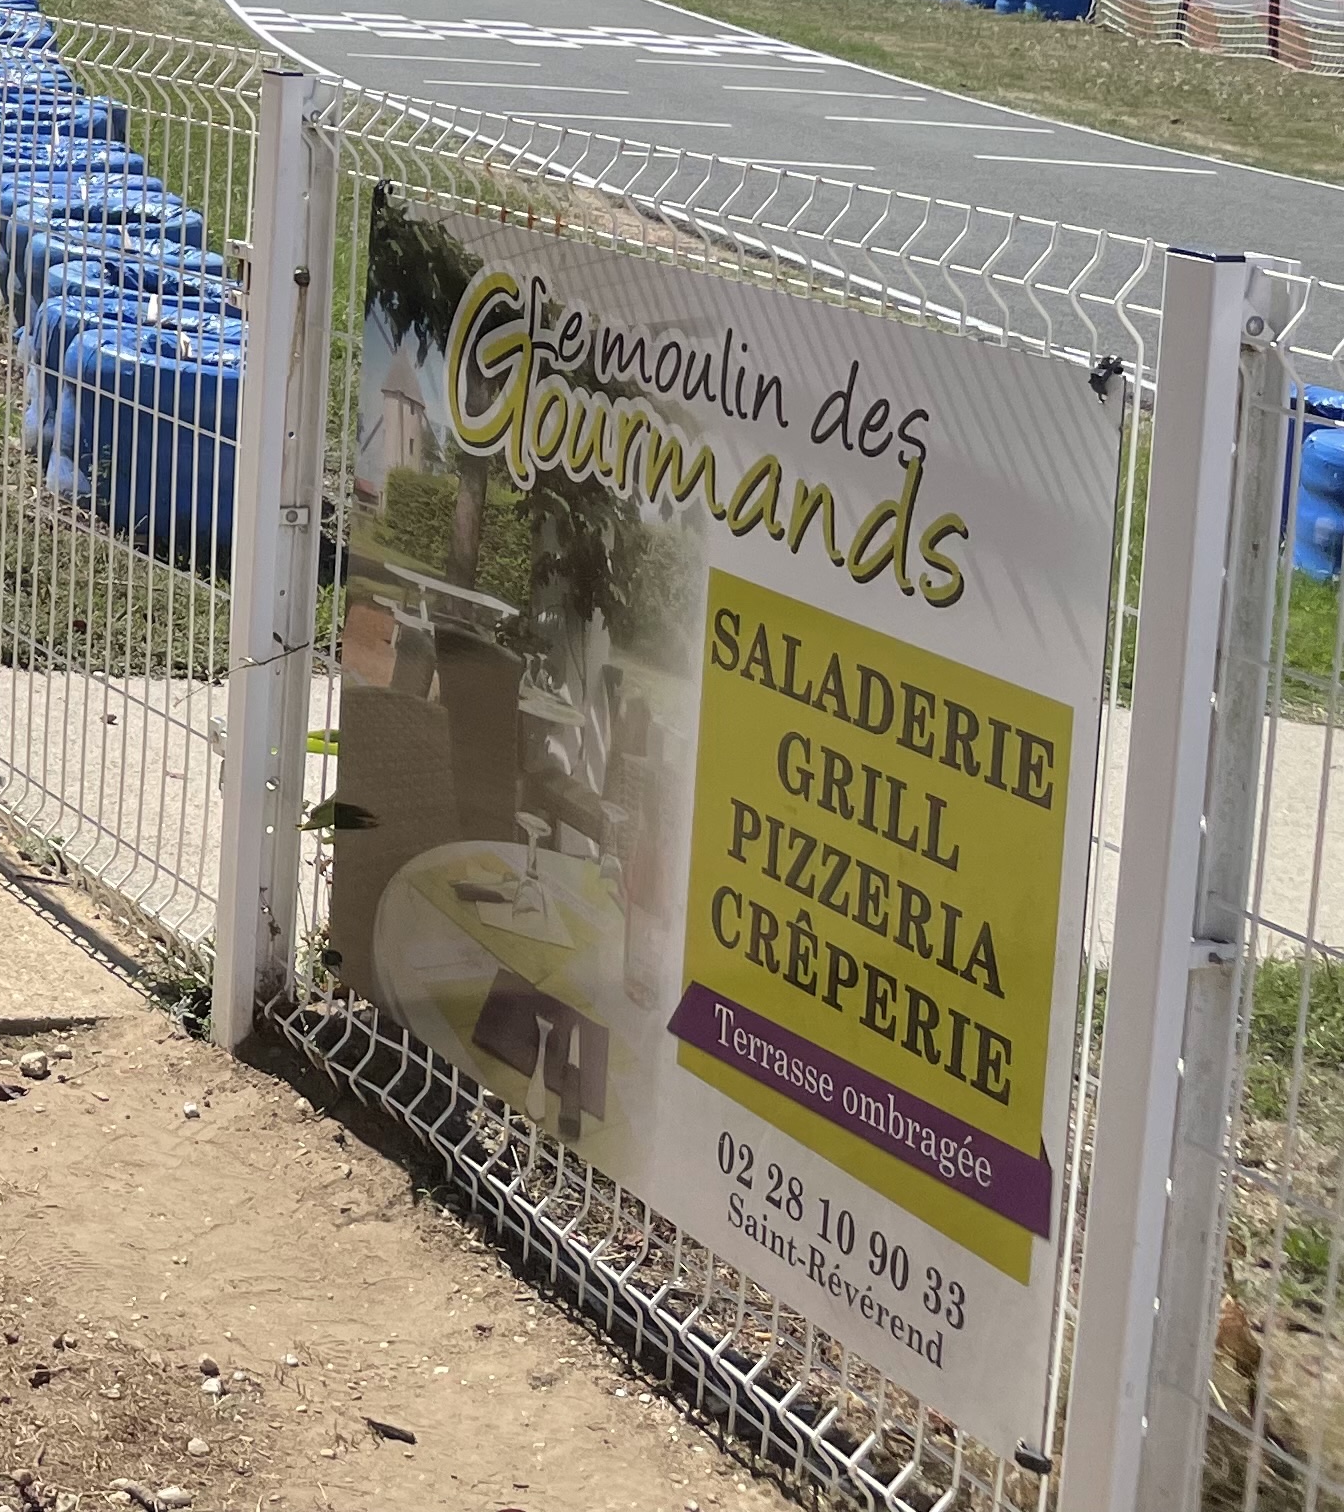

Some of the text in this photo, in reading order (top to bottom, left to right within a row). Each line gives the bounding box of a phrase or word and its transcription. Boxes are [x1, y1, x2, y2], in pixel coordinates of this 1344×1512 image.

[448, 271, 969, 608] Gourmands
[528, 276, 930, 469] Le moulin des
[711, 607, 1055, 810] SALADERIE
[777, 731, 960, 872] GRILL
[711, 885, 1012, 1106] CRÊPERIE
[727, 797, 1006, 999] PIZZERIA
[714, 1003, 993, 1188] Terrasse ombragée
[717, 1131, 966, 1331] 02 28 10 90 33
[728, 1192, 945, 1370] Saint-Révérend
